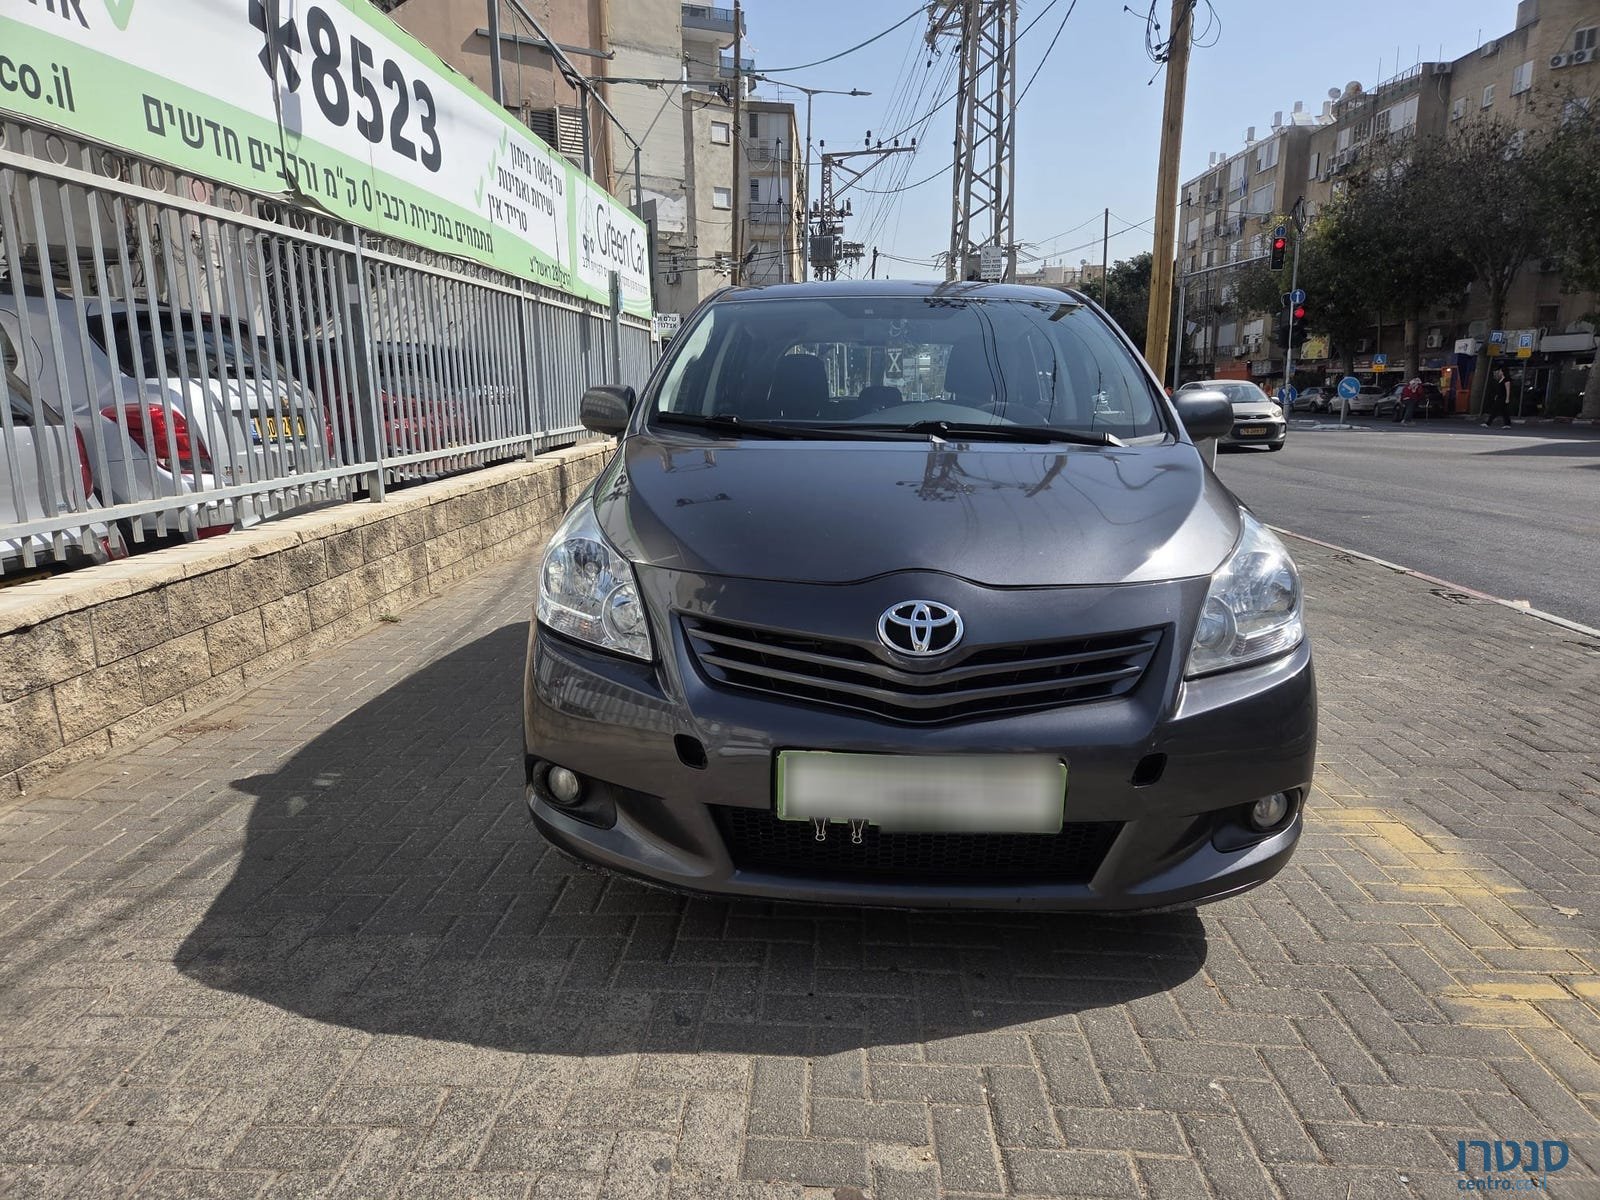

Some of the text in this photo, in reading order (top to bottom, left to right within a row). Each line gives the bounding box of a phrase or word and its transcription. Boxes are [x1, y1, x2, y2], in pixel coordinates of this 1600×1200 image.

[142, 93, 242, 164] חדשים
[247, 136, 319, 192] ורכבים
[510, 142, 563, 196] עד 100% מימון
[375, 190, 408, 225] רכבי
[487, 193, 527, 232] טרייד אין
[497, 165, 553, 216] שירות ואמינות
[410, 202, 454, 240] במכירת
[454, 220, 494, 254] מתמחים
[596, 203, 645, 276] Green Car
